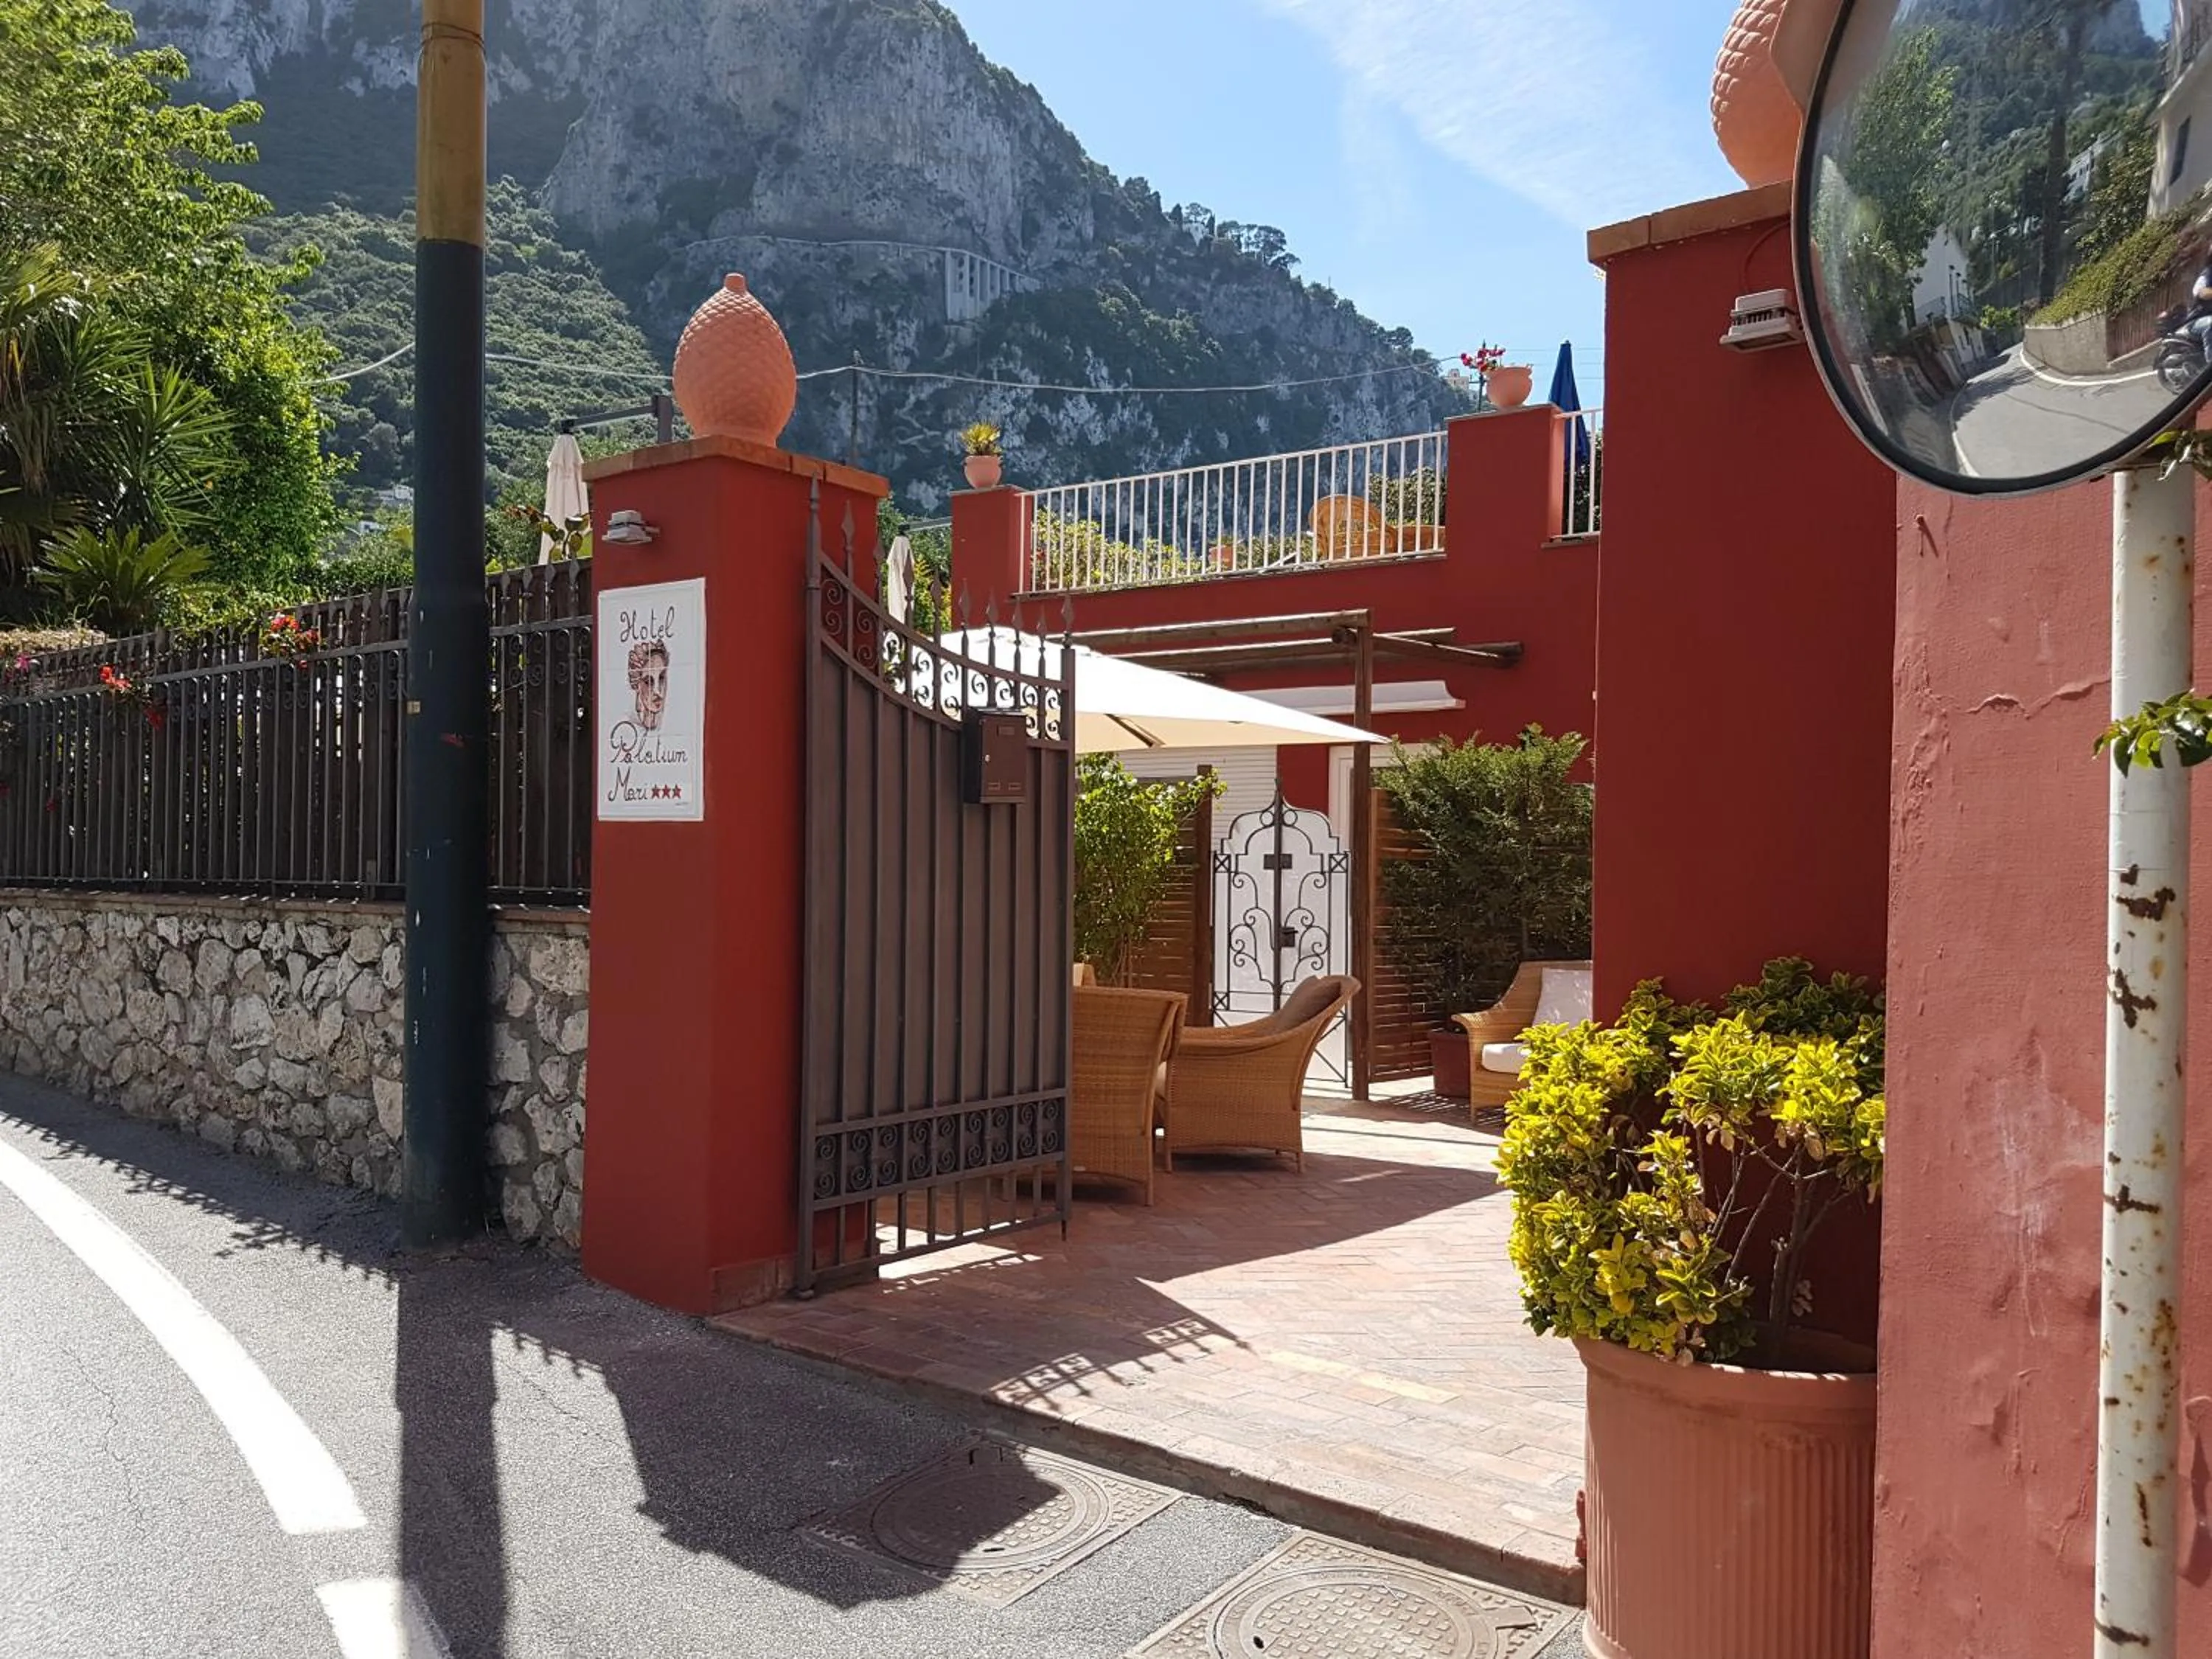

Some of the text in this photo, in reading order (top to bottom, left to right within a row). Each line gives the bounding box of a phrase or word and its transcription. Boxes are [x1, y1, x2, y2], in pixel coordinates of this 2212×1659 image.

[620, 606, 675, 642] Hotel
[610, 720, 688, 764] Palatium
[608, 767, 647, 801] Mari
